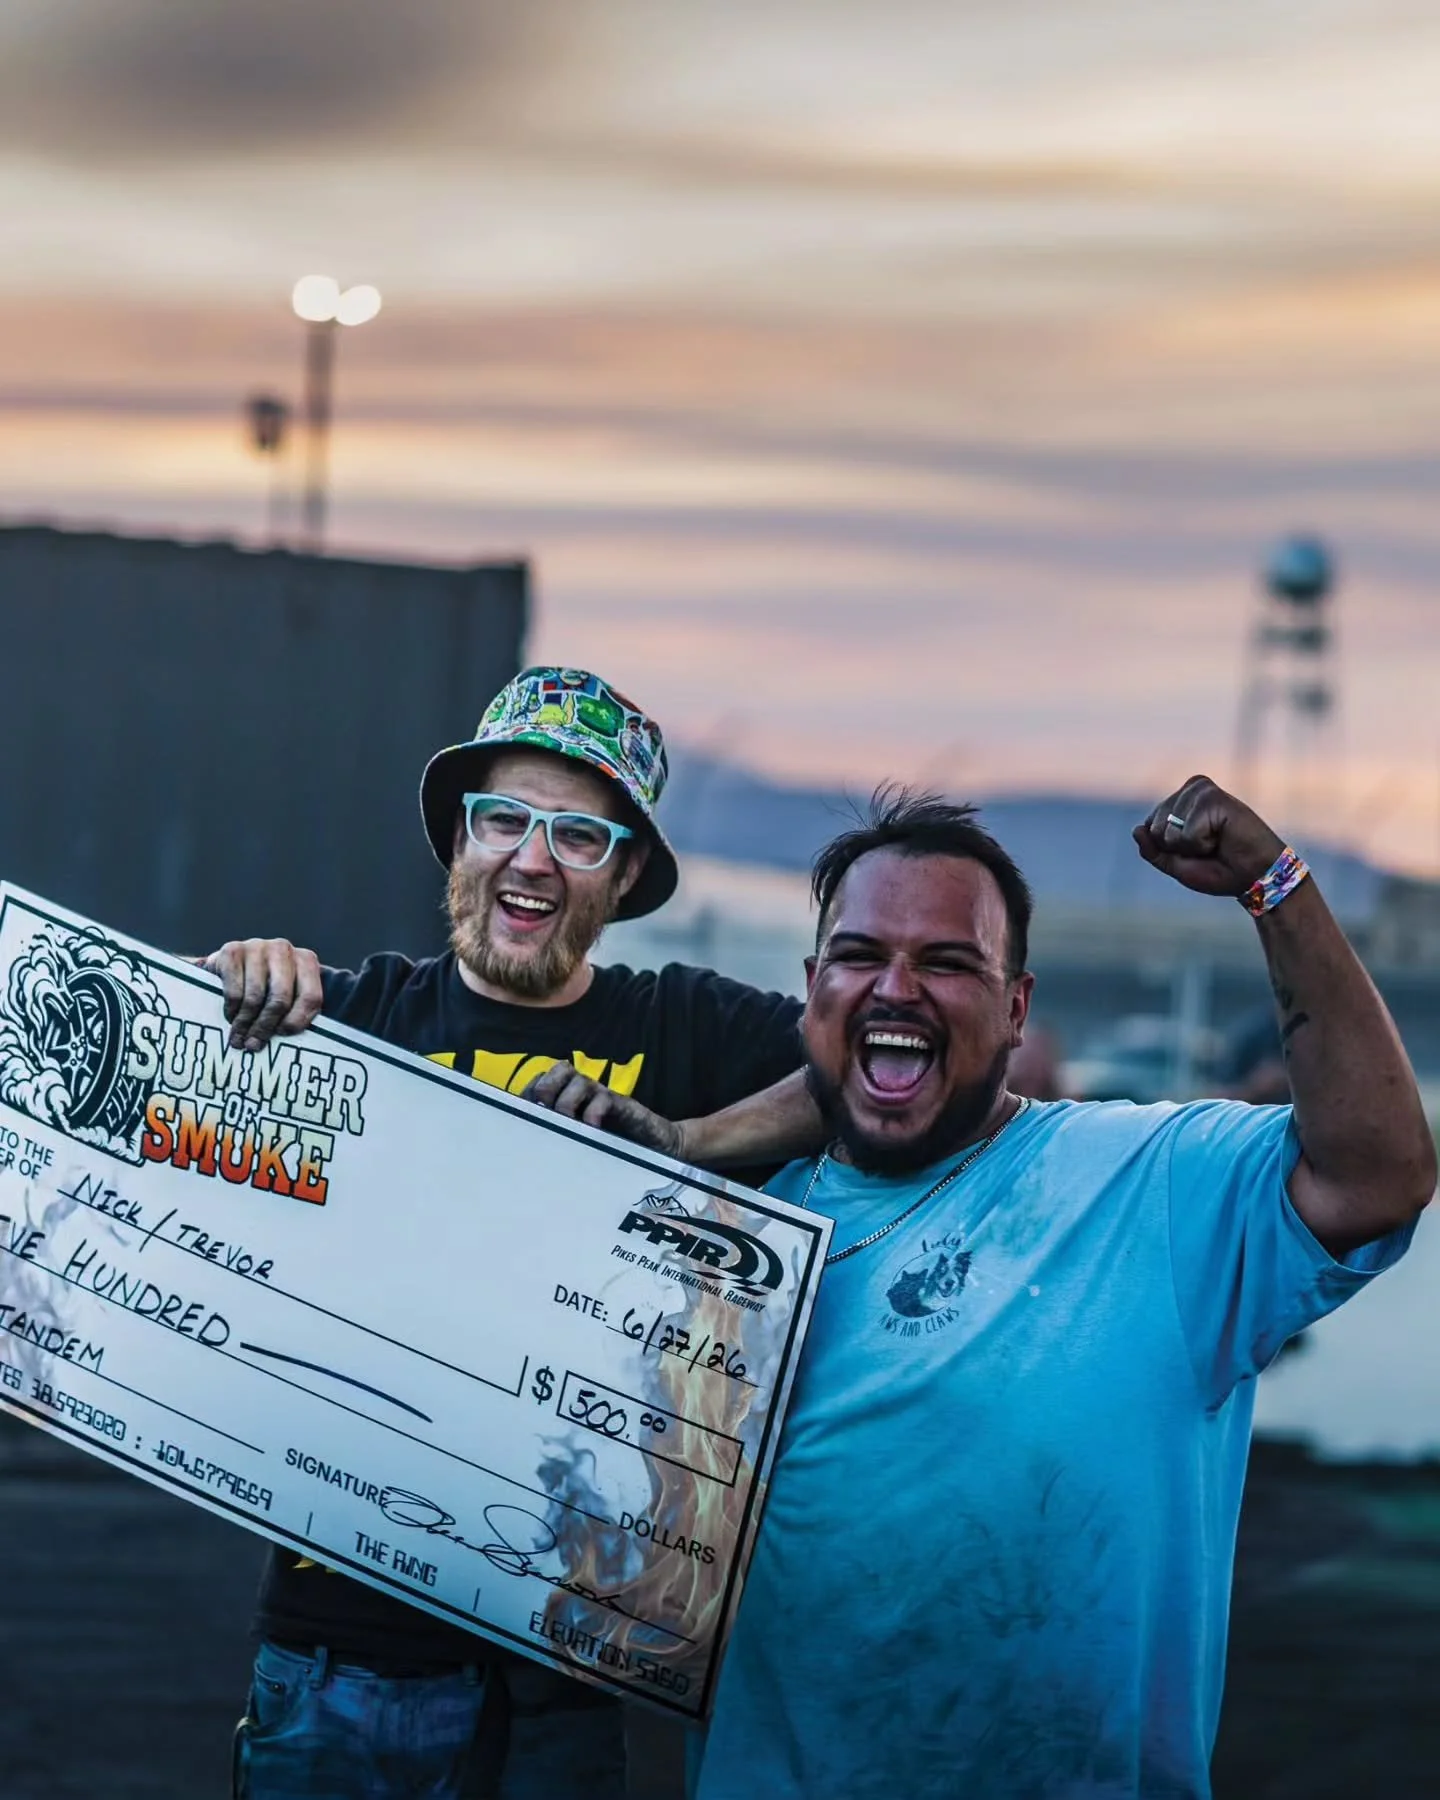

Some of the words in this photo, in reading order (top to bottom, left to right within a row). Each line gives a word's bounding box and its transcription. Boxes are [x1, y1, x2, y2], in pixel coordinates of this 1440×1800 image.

[127, 1012, 367, 1136] SUMMER
[223, 1092, 254, 1125] OF
[0, 1126, 19, 1149] TO
[24, 1138, 54, 1167] THE
[19, 1159, 41, 1180] OF
[142, 1095, 334, 1206] SMOKE
[73, 1173, 142, 1225] NICK
[179, 1224, 273, 1279] TREVOR
[618, 1210, 729, 1269] PPIR
[63, 1239, 230, 1346] HUNDRED
[900, 1321, 921, 1337] AND
[925, 1306, 960, 1334] CLAWS
[0, 1304, 104, 1372] TANDEM
[553, 1284, 608, 1322] DATE:
[622, 1308, 747, 1379] 6/27/26
[531, 1366, 555, 1405] $
[285, 1448, 390, 1509] SIGNATURE
[355, 1531, 390, 1565] THE
[392, 1549, 438, 1587] RING
[619, 1511, 716, 1565] DOLLARS
[528, 1611, 632, 1673] ELEVATION
